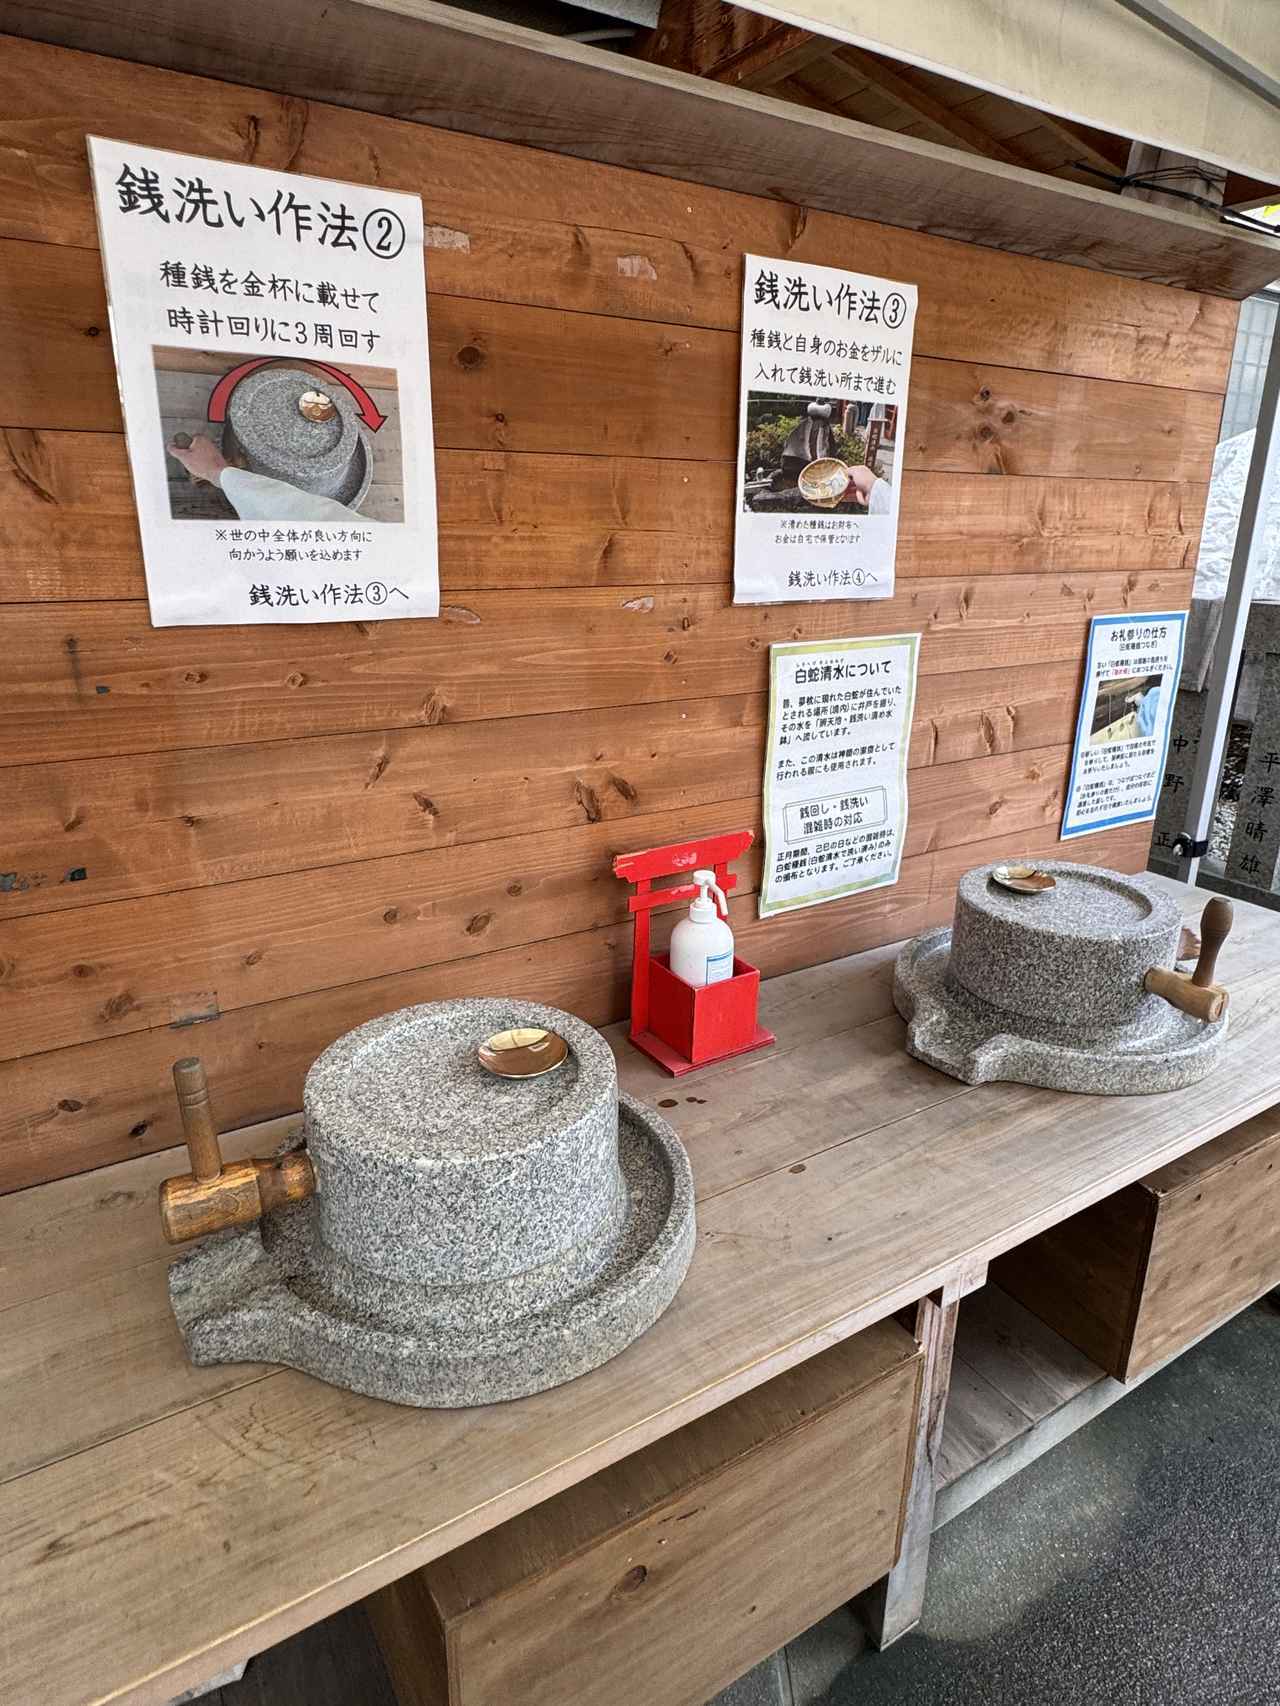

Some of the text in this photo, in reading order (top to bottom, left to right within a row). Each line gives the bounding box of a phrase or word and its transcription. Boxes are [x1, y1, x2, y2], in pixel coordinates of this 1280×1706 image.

[114, 163, 406, 260] 銭洗い作法②
[159, 260, 381, 313] 種銭を金杯に載せて
[753, 269, 907, 330] 銭洗い作法③
[166, 306, 382, 354] 時計回りに3周回す
[750, 328, 903, 366] 種銭と自身のお金をザルに
[754, 362, 897, 395] 入れて銭洗い所まで進む
[215, 528, 373, 543] ※世の中全体が良い方向に
[228, 547, 363, 562] 向かうよう願いを込めます
[787, 568, 878, 588] 銭洗い作法④へ
[248, 580, 410, 608] 銭洗い作法③へ
[794, 660, 892, 684] 白蛇清水について
[799, 796, 869, 819] 銭回し・銭洗い
[803, 812, 863, 835] 混雑時の対応
